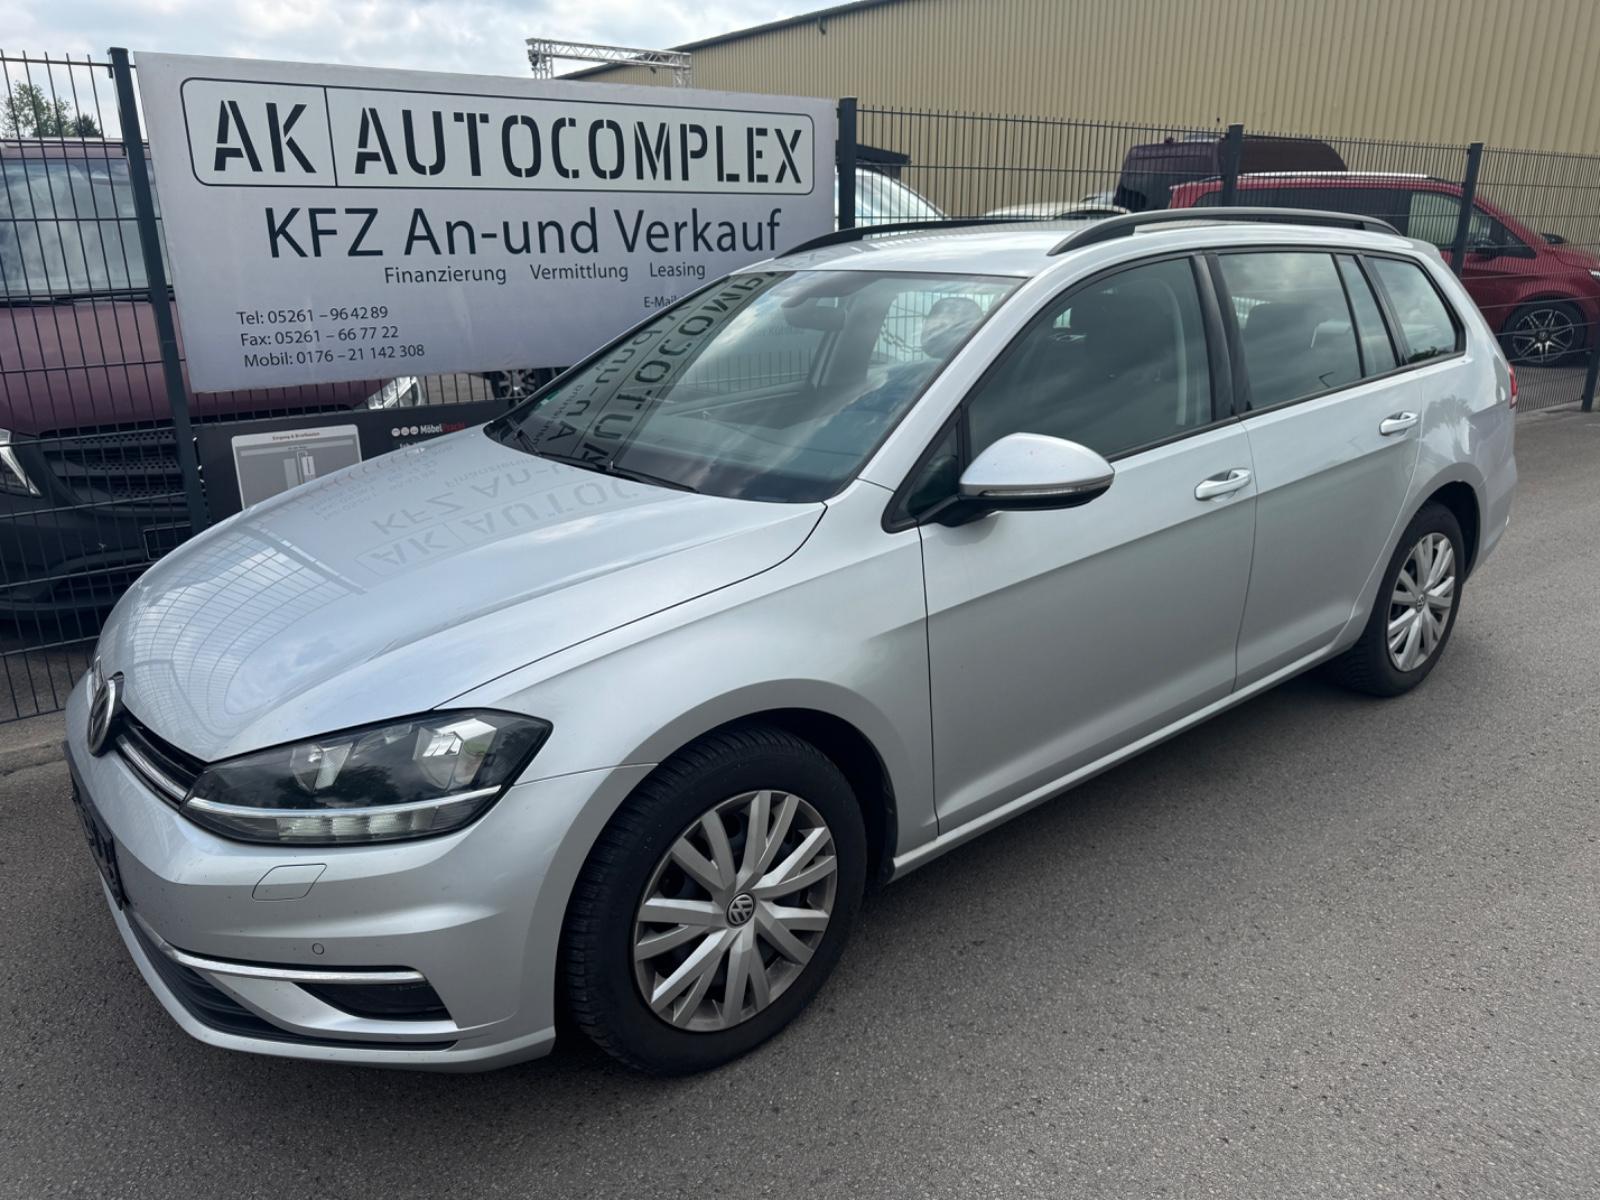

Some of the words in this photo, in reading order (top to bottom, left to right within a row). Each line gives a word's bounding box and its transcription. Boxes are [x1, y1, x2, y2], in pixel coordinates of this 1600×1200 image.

[213, 99, 317, 174] AK
[354, 106, 802, 185] AUTOCOMPLEX
[265, 207, 384, 259] KFZ
[403, 207, 599, 256] An-und
[613, 208, 782, 253] Verkauf
[384, 265, 506, 286] Finanzierung
[529, 262, 629, 282] Vermittlung
[650, 261, 706, 280] Leasing
[236, 310, 264, 326] Tel:
[268, 309, 314, 325] 05261
[240, 331, 272, 347] Fax:
[275, 330, 321, 345] 05261
[244, 353, 294, 368] Mobil:
[296, 349, 334, 365] 0176
